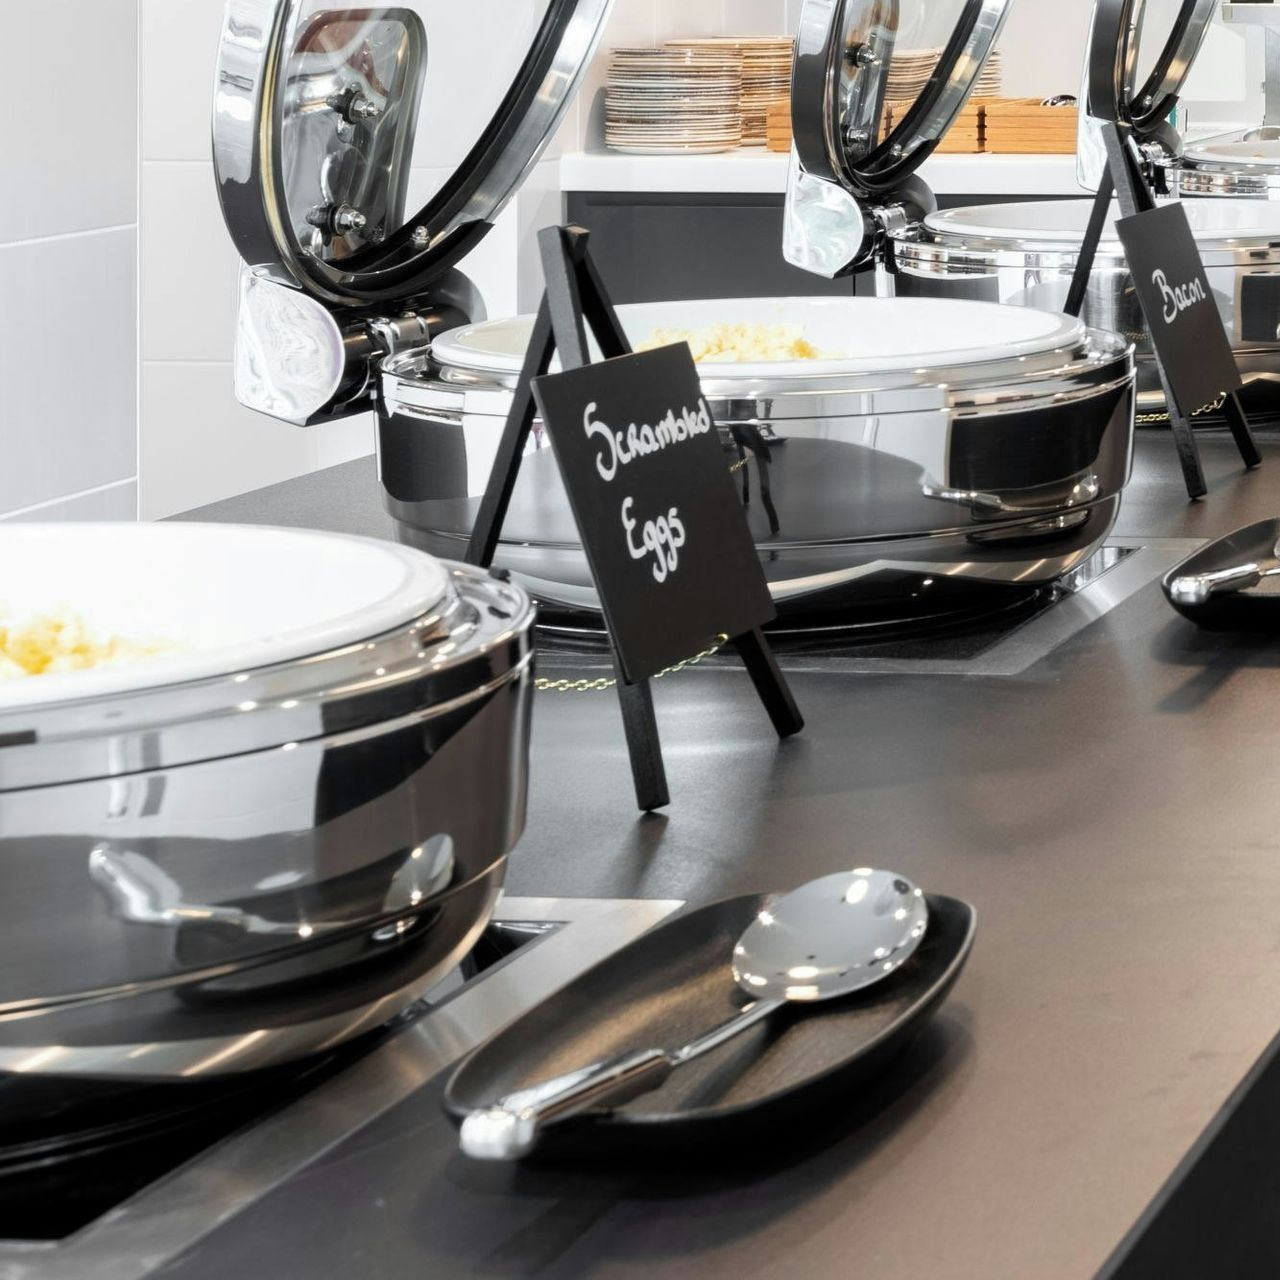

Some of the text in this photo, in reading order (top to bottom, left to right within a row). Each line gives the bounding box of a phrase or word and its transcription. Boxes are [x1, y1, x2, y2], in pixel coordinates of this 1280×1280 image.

[1151, 268, 1207, 324] Bacon
[583, 398, 711, 481] Scrambled
[621, 496, 686, 583] Eggs
